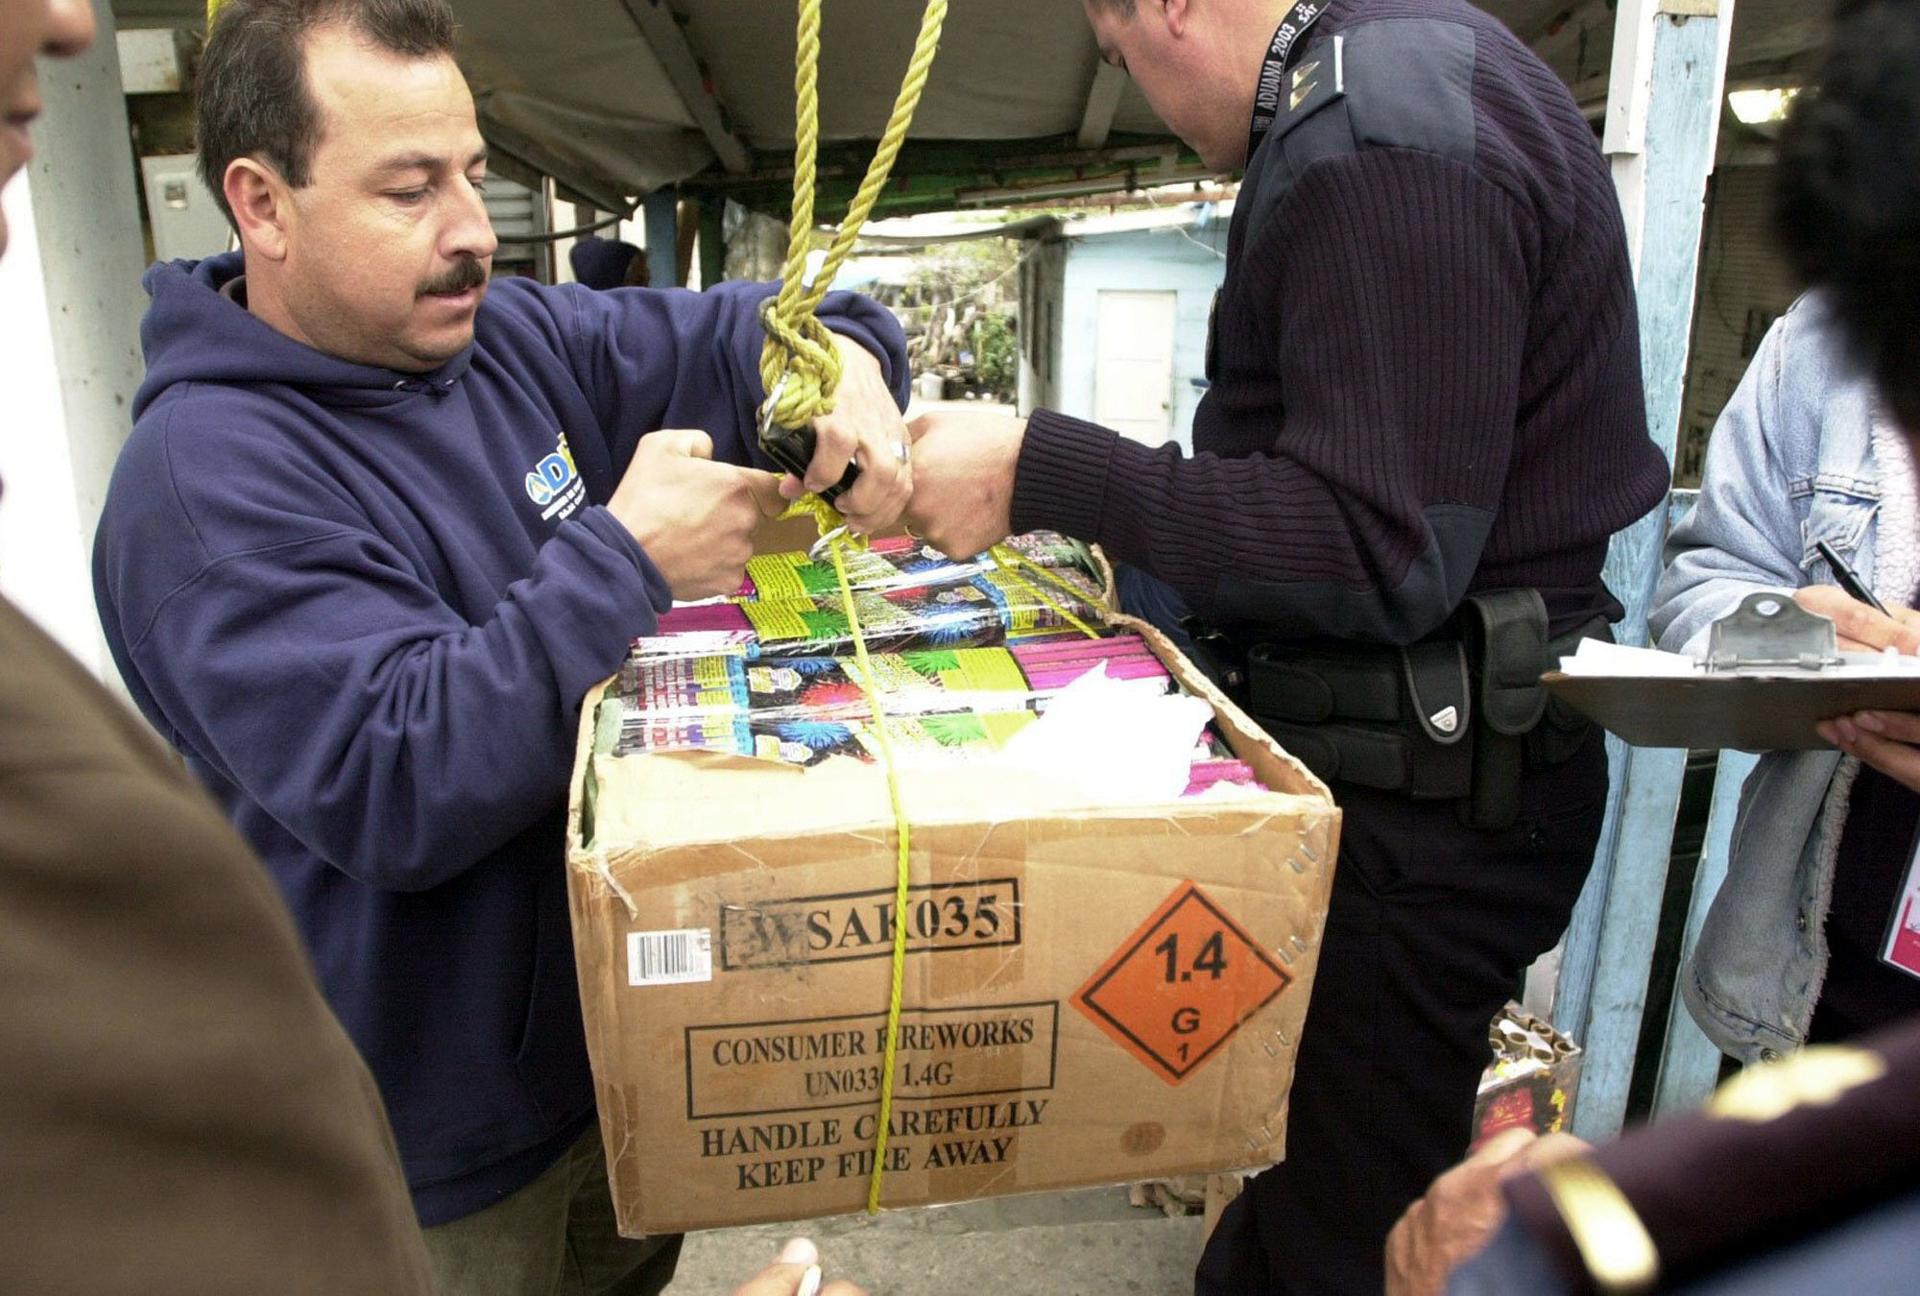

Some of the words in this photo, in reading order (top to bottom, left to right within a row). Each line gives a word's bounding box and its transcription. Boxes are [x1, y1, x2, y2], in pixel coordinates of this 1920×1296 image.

[1257, 60, 1283, 111] ADUANA
[1271, 22, 1297, 57] 2003
[1155, 931, 1227, 983] 1.4
[712, 1030, 866, 1067] CONSUMER
[876, 1018, 1034, 1053] FREWORKS
[1171, 1007, 1200, 1034] G
[1177, 1043, 1189, 1062] 1
[805, 1066, 885, 1098] UN033
[903, 1062, 953, 1086] 1.4G
[701, 1119, 842, 1157] HANDLE
[854, 1099, 1048, 1141] CAREFULLY
[736, 1157, 825, 1190] KEEP
[837, 1146, 911, 1179] FIRE
[923, 1137, 1013, 1169] AWAY
